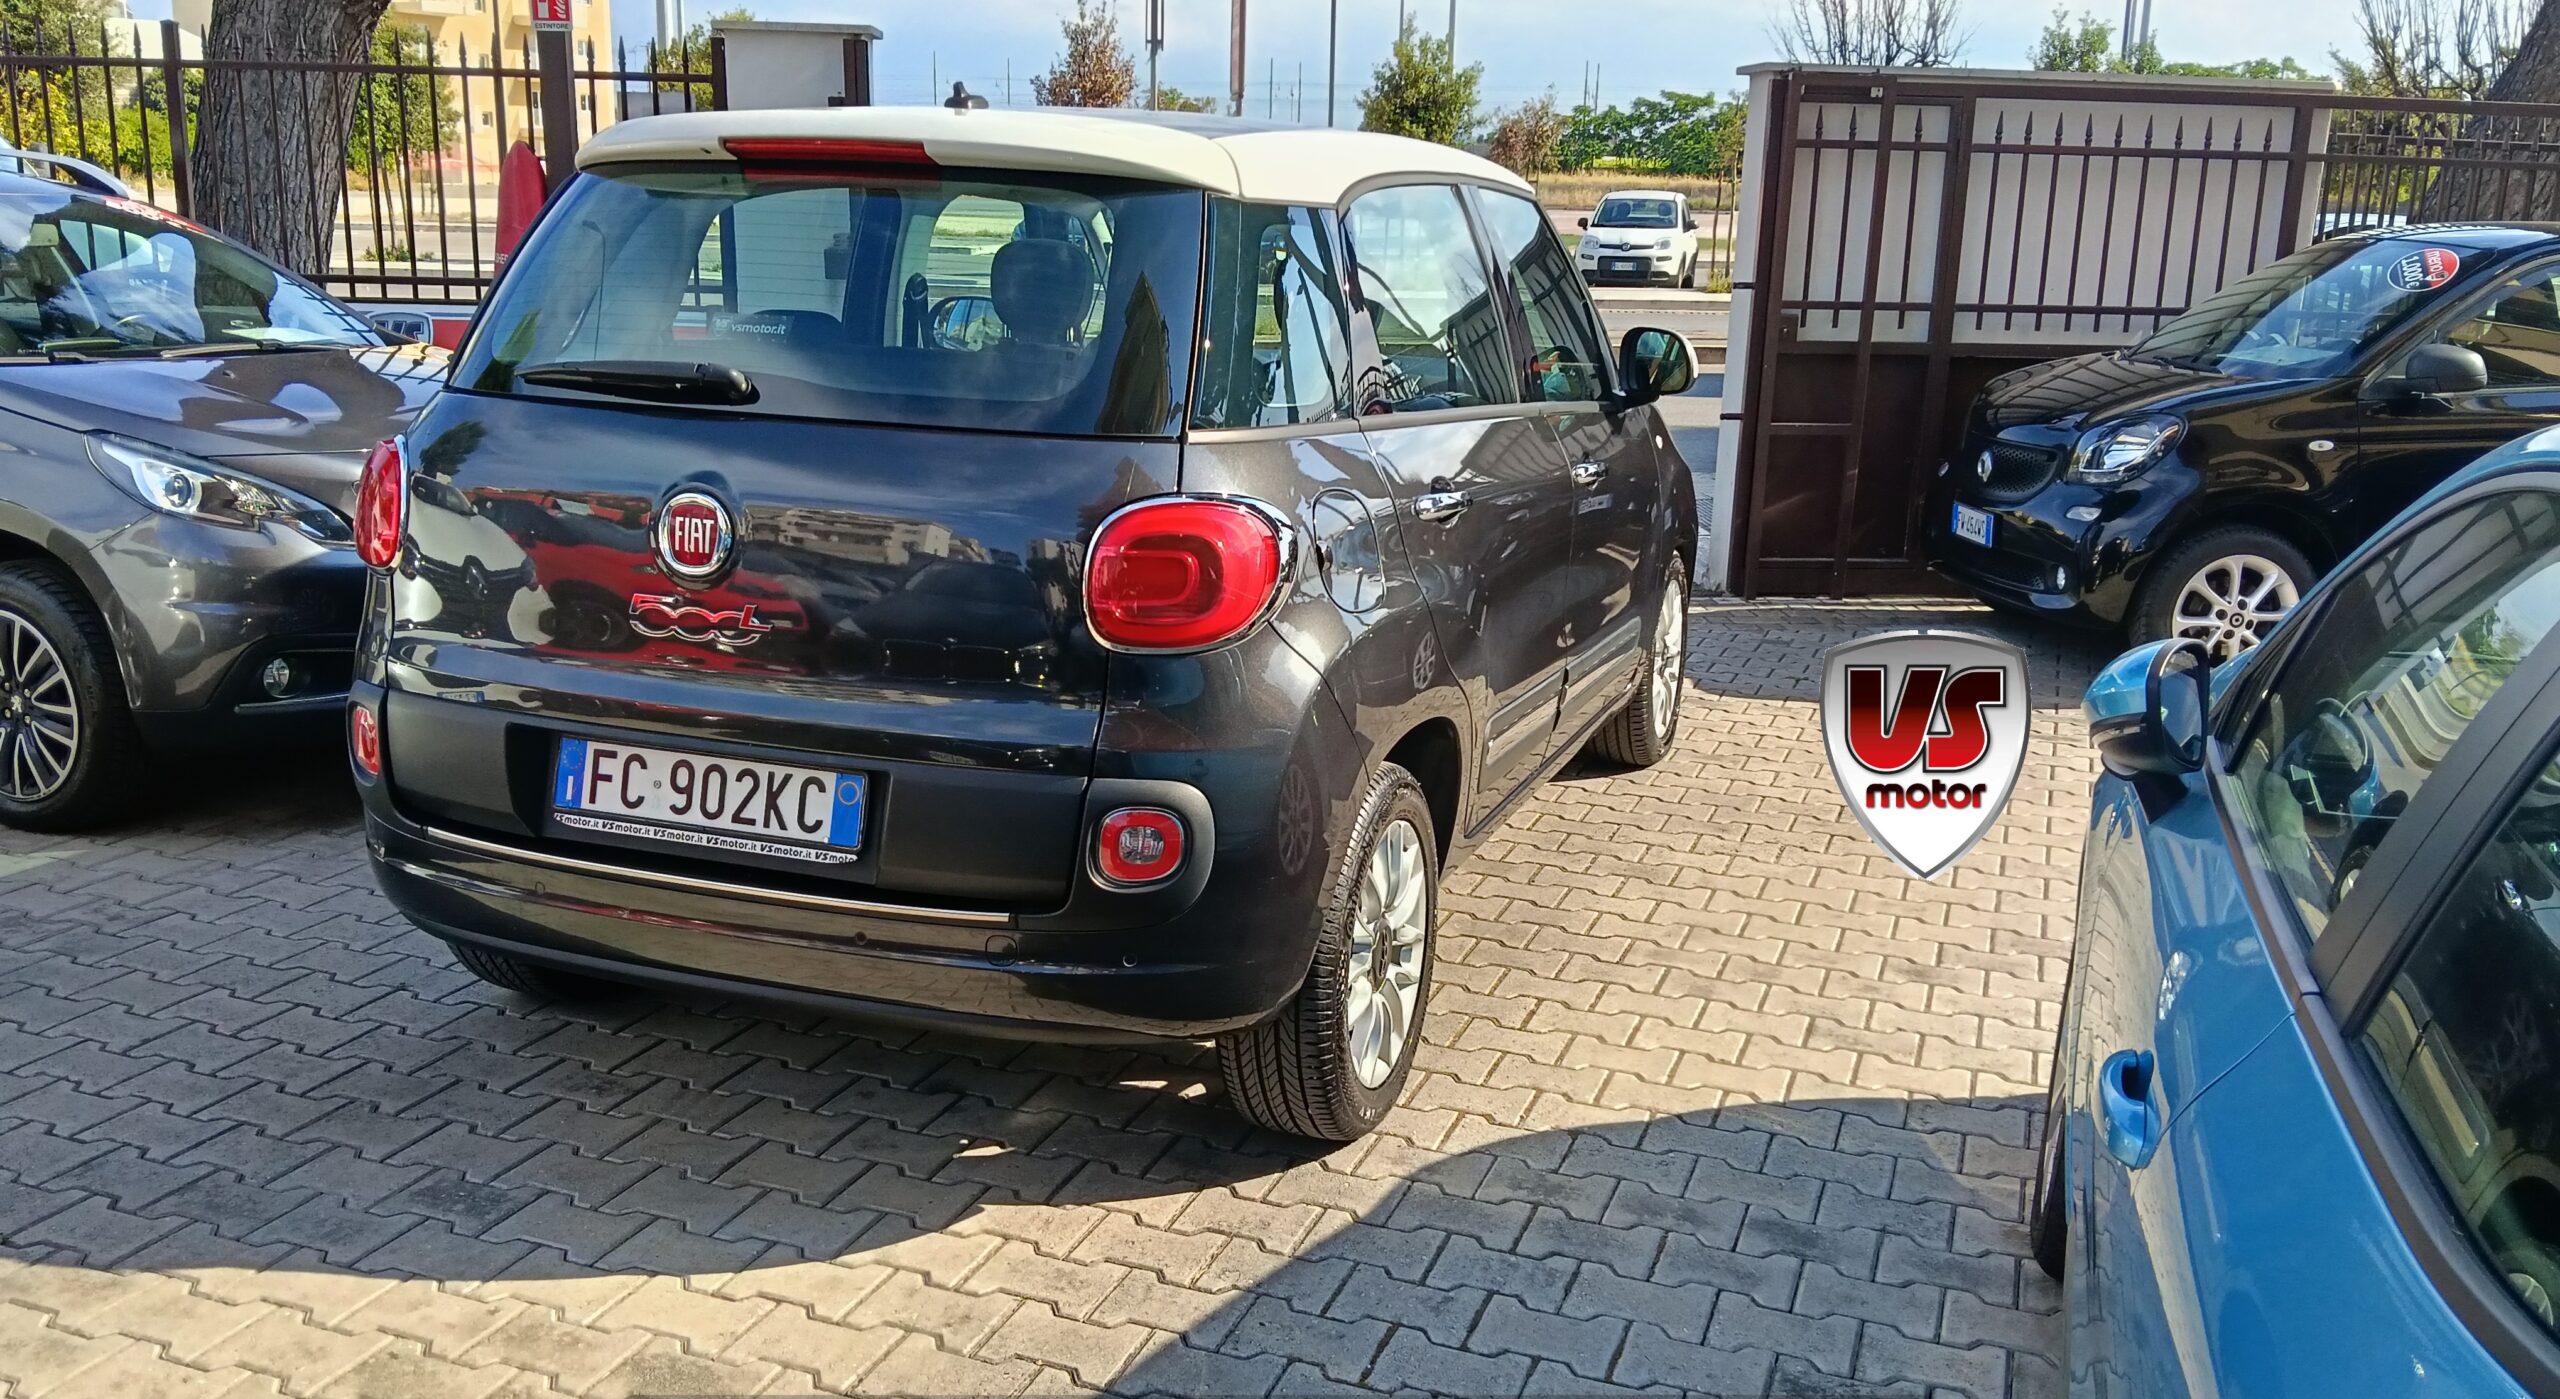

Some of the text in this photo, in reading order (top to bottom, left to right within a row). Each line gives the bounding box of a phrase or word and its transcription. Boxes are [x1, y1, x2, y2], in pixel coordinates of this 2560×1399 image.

[534, 22, 569, 30] ESTINTORE
[2426, 250, 2444, 273] meno
[731, 323, 787, 335] vsmotor.it
[674, 516, 715, 554] FIAT
[629, 593, 775, 646] 500L
[601, 821, 650, 836] VSmotor.it
[653, 829, 703, 843] VSmotor.it
[706, 836, 757, 851] VSmotor.it
[760, 844, 812, 859] VSmotor.it
